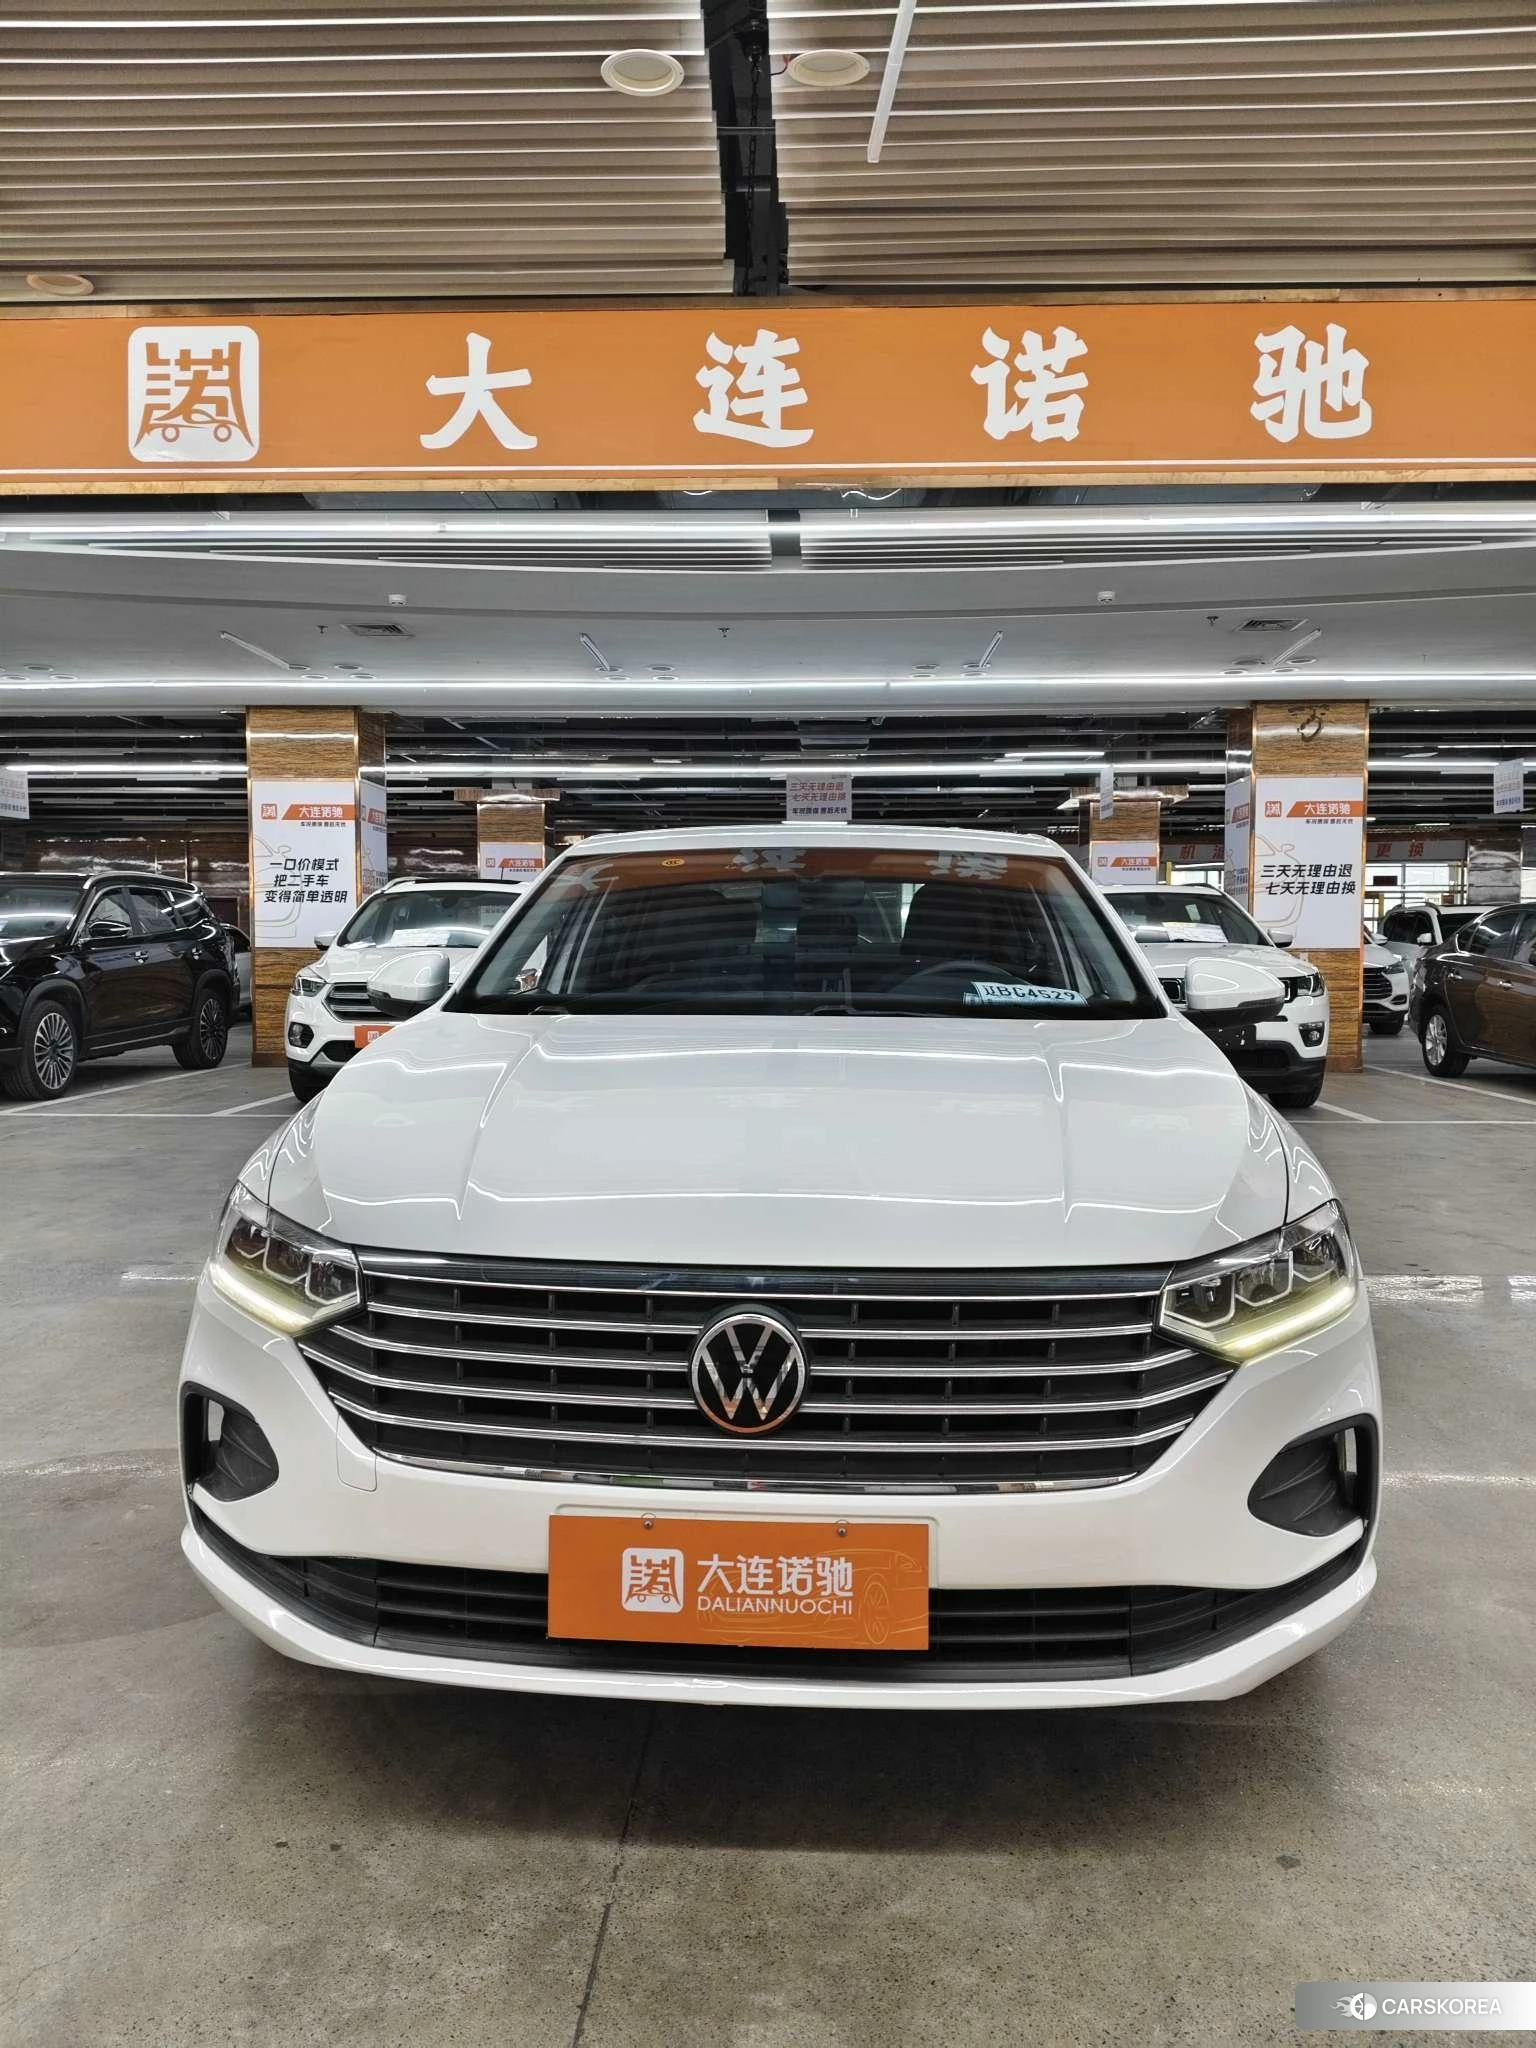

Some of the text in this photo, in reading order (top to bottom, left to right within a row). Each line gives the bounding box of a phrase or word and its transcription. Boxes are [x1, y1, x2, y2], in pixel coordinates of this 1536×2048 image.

[420, 323, 1373, 449] 大连诺驰
[300, 806, 343, 818] 大连诺驰
[1304, 803, 1351, 815] 大连诺驰
[270, 858, 339, 871] 一口价模式
[1261, 864, 1352, 878] 三天无理由退
[274, 874, 329, 887] 把二手车
[1266, 881, 1356, 895] 七天无理由换
[264, 890, 347, 903] 变得简单透明
[697, 1553, 853, 1597] 大连诺驰
[697, 1596, 853, 1616] DALIANNUOCHI
